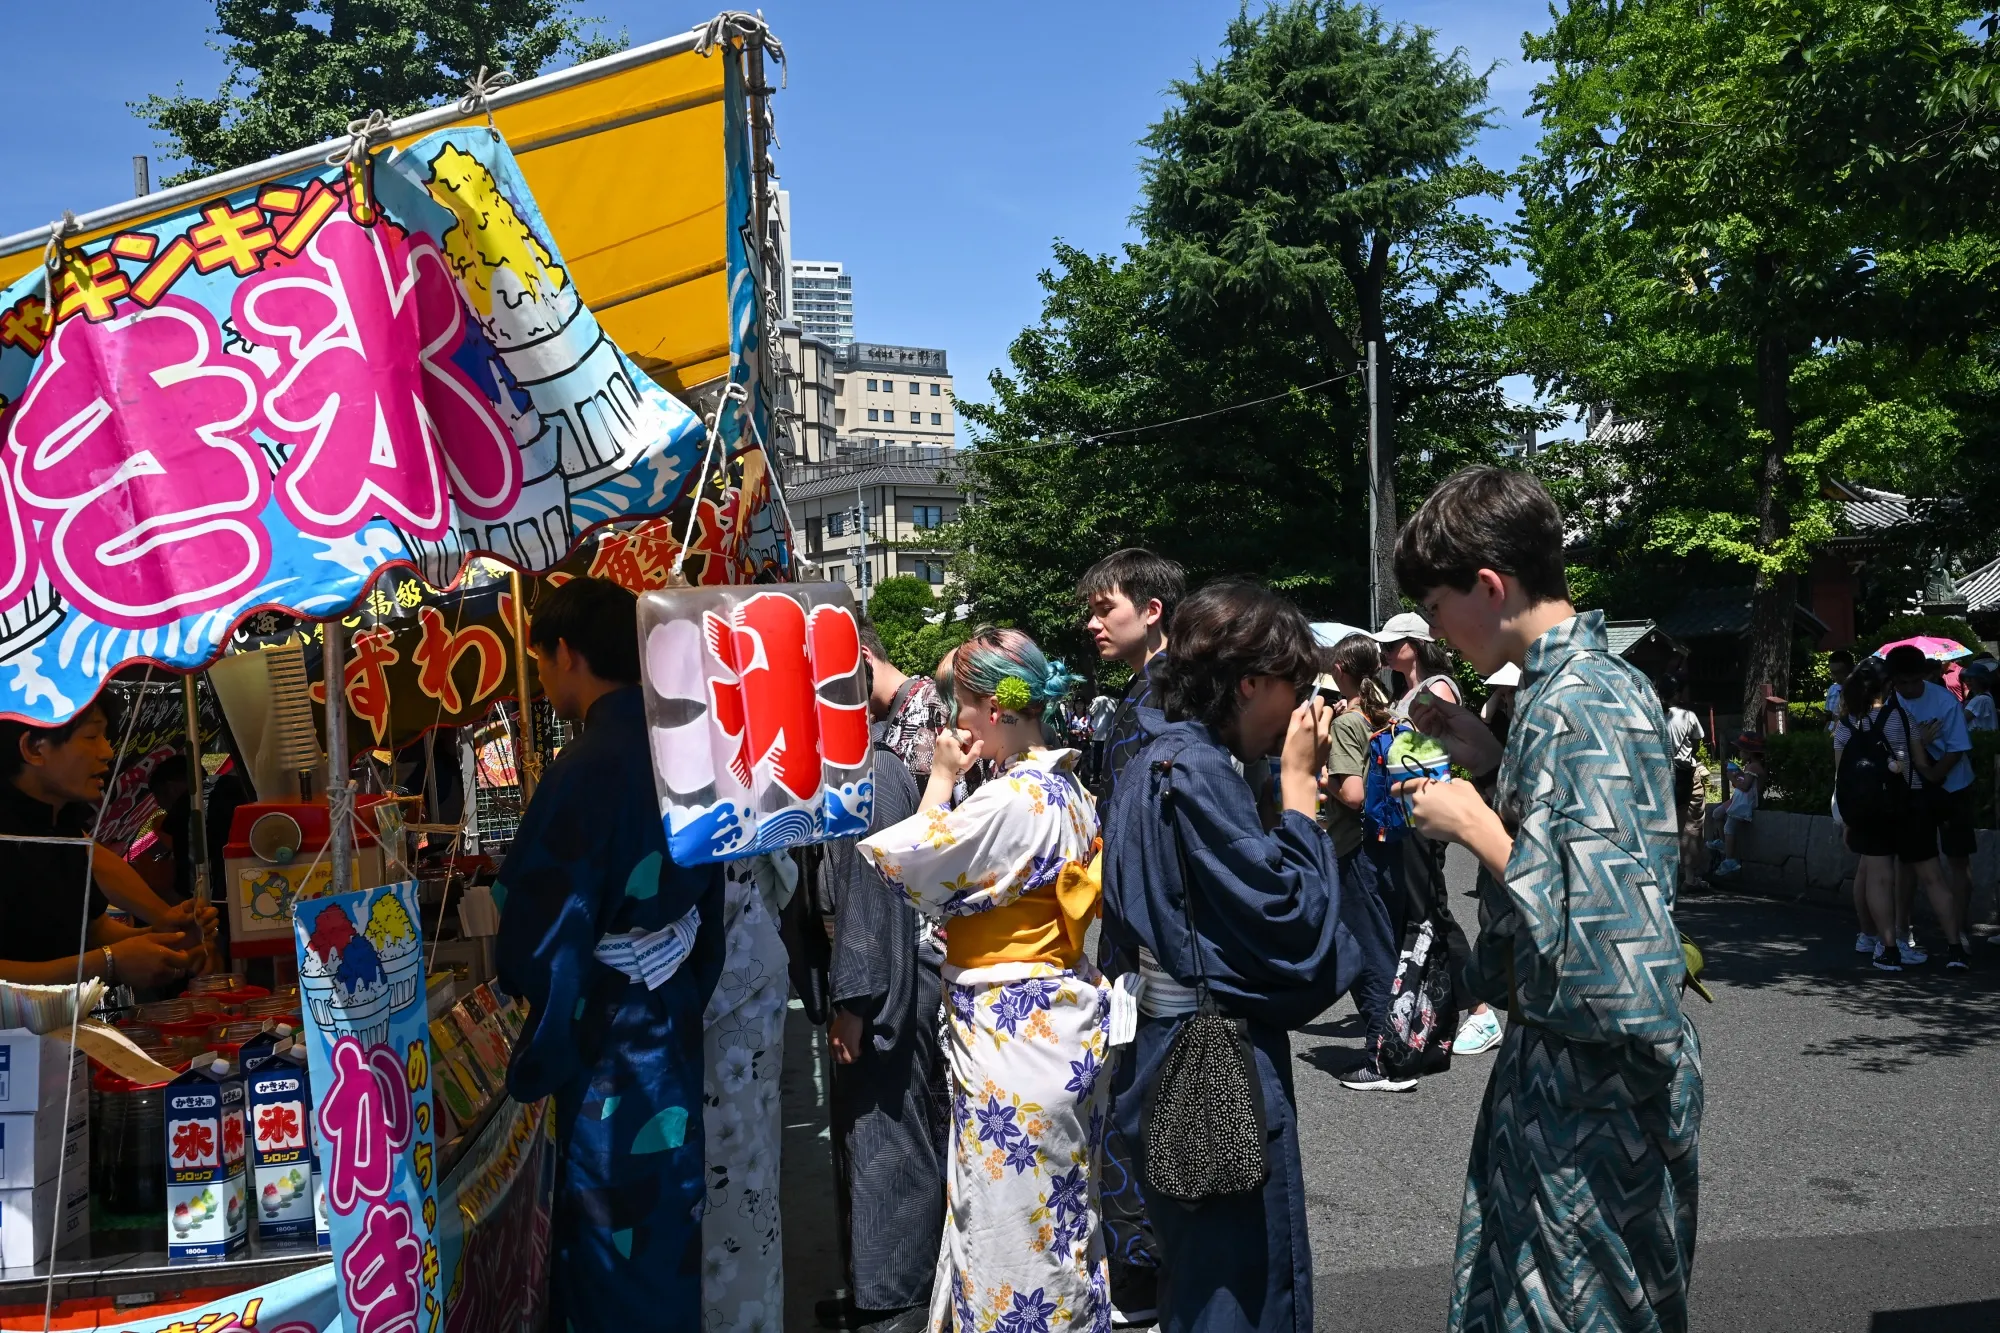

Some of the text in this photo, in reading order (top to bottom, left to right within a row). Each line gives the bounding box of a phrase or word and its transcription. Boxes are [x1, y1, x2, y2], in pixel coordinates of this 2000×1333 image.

[0, 207, 523, 630] き氷
[703, 592, 871, 801] 氷
[259, 1081, 296, 1092] かき氷用
[175, 1097, 212, 1109] かき氷用
[258, 1105, 298, 1143] 氷
[171, 1122, 214, 1160] 氷
[263, 1151, 300, 1163] シロップ
[175, 1169, 213, 1182] シロップ
[185, 1247, 208, 1255] 1800ml
